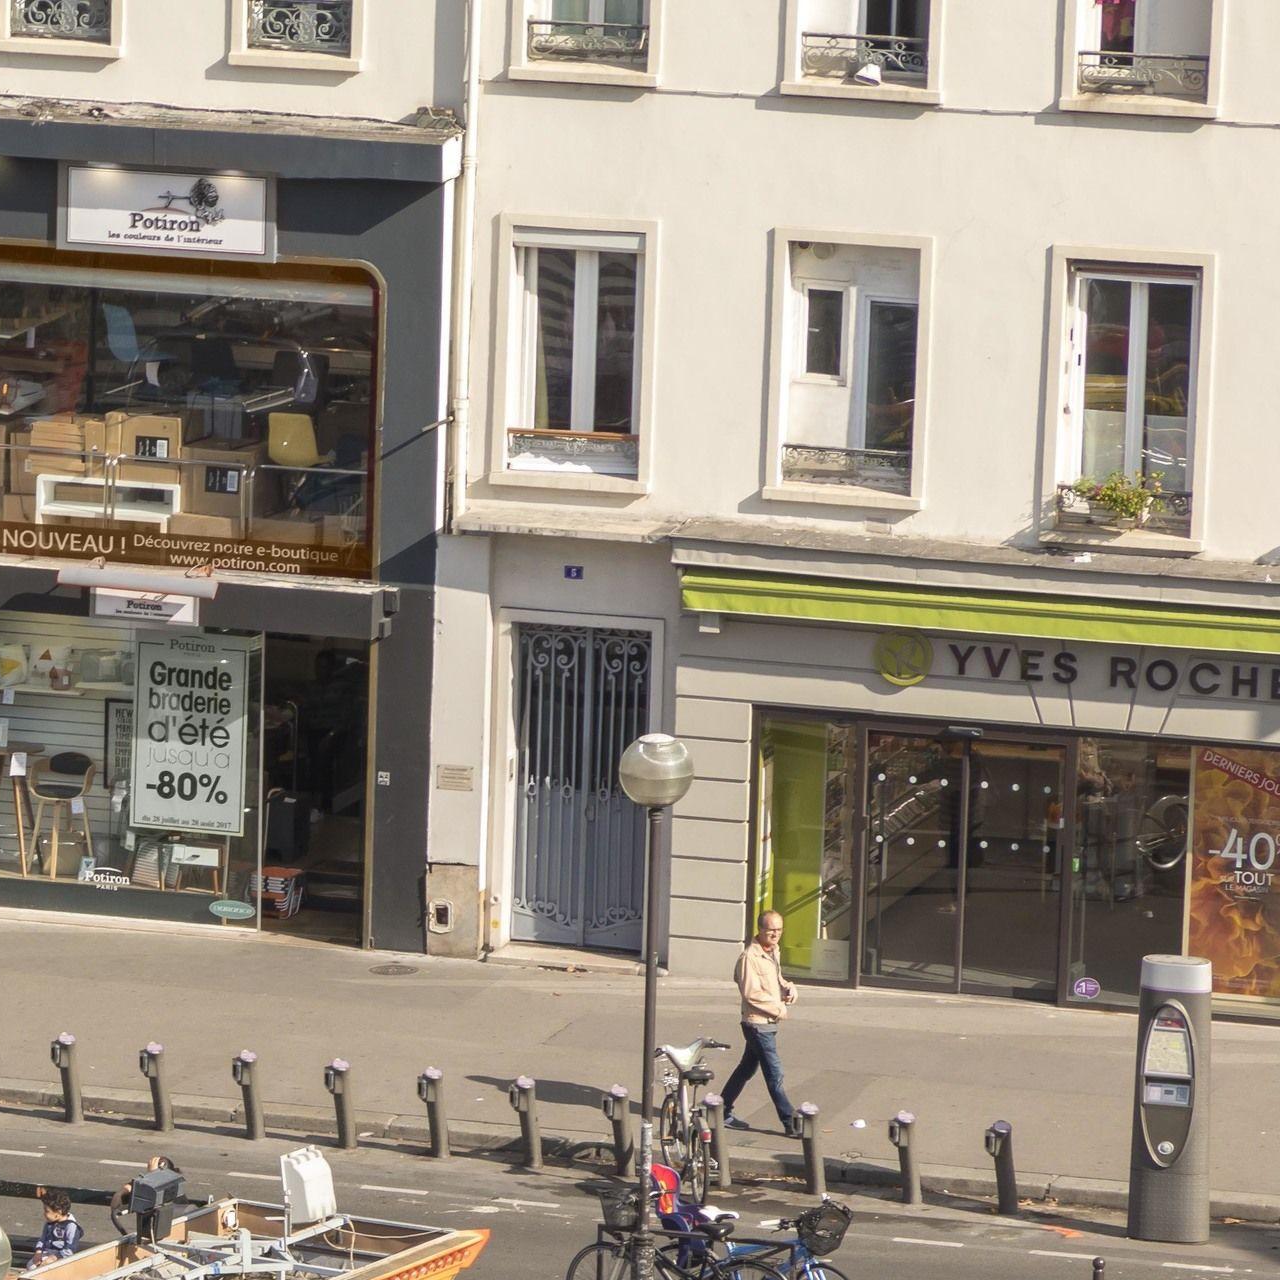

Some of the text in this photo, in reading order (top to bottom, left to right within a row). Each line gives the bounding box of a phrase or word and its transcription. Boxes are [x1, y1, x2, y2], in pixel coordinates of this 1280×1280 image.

[129, 212, 201, 232] Potiron
[108, 230, 121, 239] les
[123, 231, 161, 241] couleurs
[164, 233, 175, 243] de
[2, 528, 127, 555] NOUVEAU !
[133, 533, 339, 565] Découvrez notre e-boutique
[169, 552, 301, 575] www.potiron.com
[169, 639, 216, 653] Potiron
[149, 660, 232, 691] Grande
[948, 643, 1078, 685] YVES
[148, 687, 231, 715] braderie
[147, 714, 231, 748] d'été
[1203, 750, 1261, 786] DERNIERS
[146, 770, 228, 805] -80%
[1208, 827, 1280, 871] -40
[85, 870, 131, 886] Potiron
[1225, 884, 1234, 892] LE
[1234, 870, 1275, 887] TOUT
